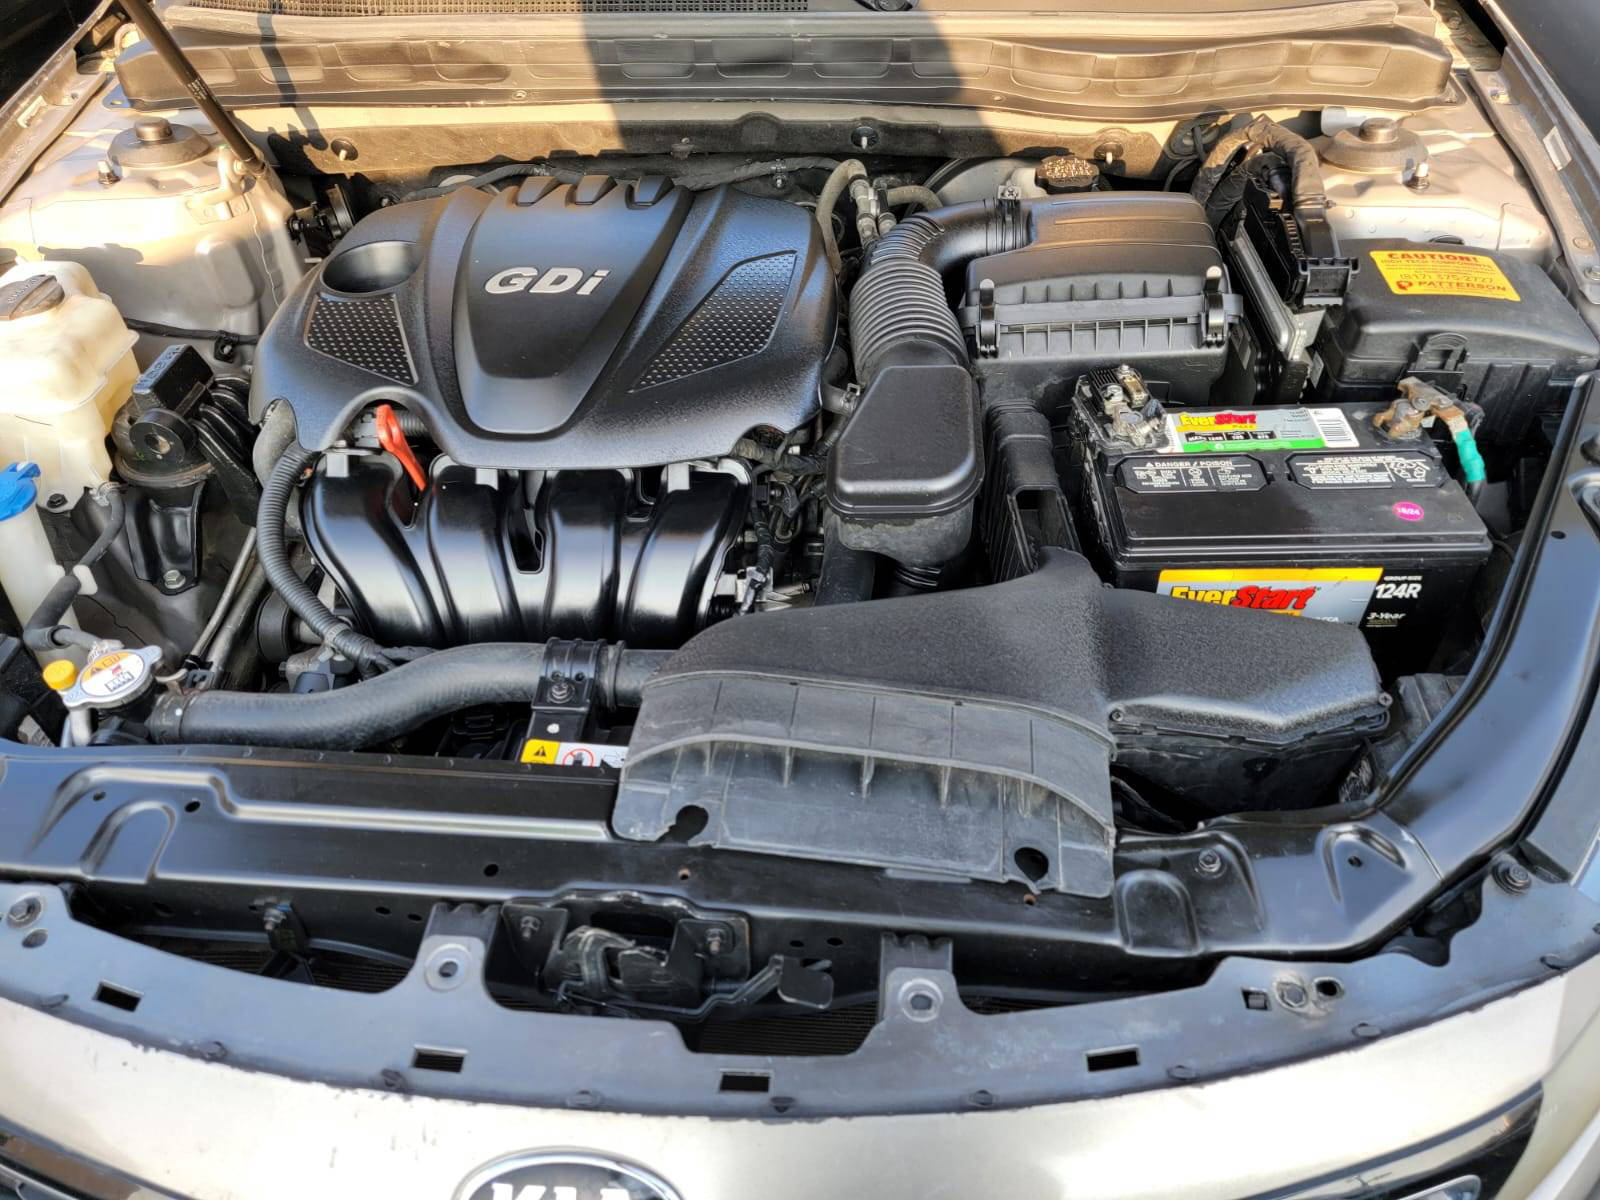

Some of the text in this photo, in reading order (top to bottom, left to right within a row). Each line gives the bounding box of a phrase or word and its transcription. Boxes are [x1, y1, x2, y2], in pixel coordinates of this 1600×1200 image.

[1387, 253, 1479, 262] CAUTION!
[485, 267, 610, 295] GDi
[1418, 281, 1507, 291] PATTERSON
[1199, 459, 1233, 467] POISON
[1375, 583, 1422, 599] 124R
